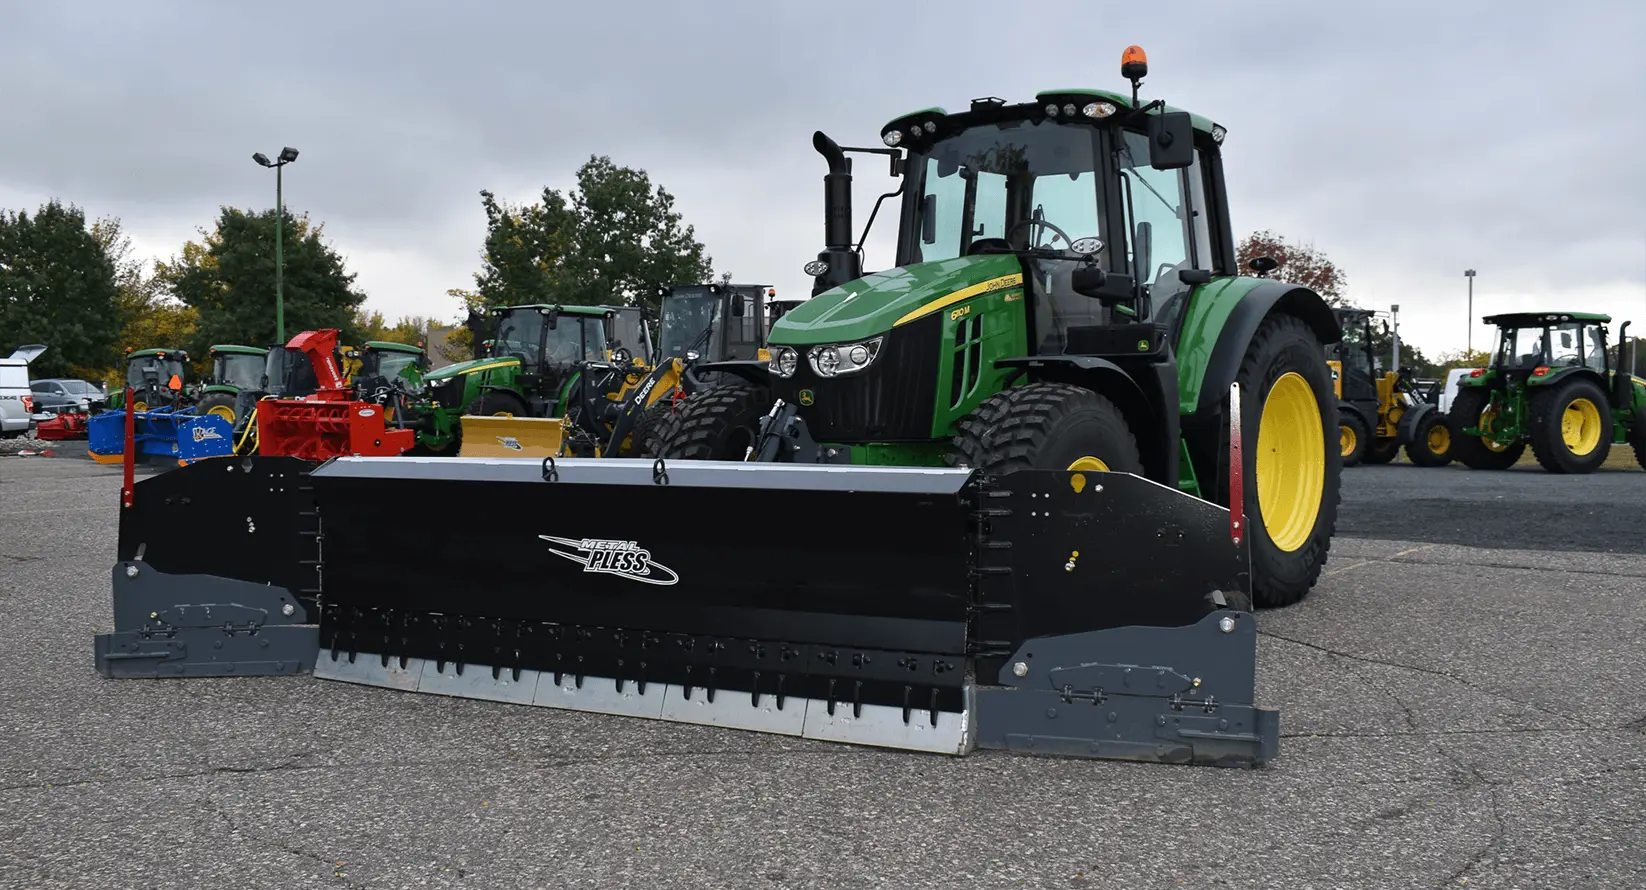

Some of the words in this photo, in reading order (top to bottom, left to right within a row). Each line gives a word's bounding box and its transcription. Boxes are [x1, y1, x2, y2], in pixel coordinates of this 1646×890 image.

[986, 280, 1000, 292] JOHN
[1000, 277, 1016, 288] DEERE
[634, 377, 656, 405] DEERE
[580, 540, 640, 552] METAL
[587, 550, 649, 573] PLESS
